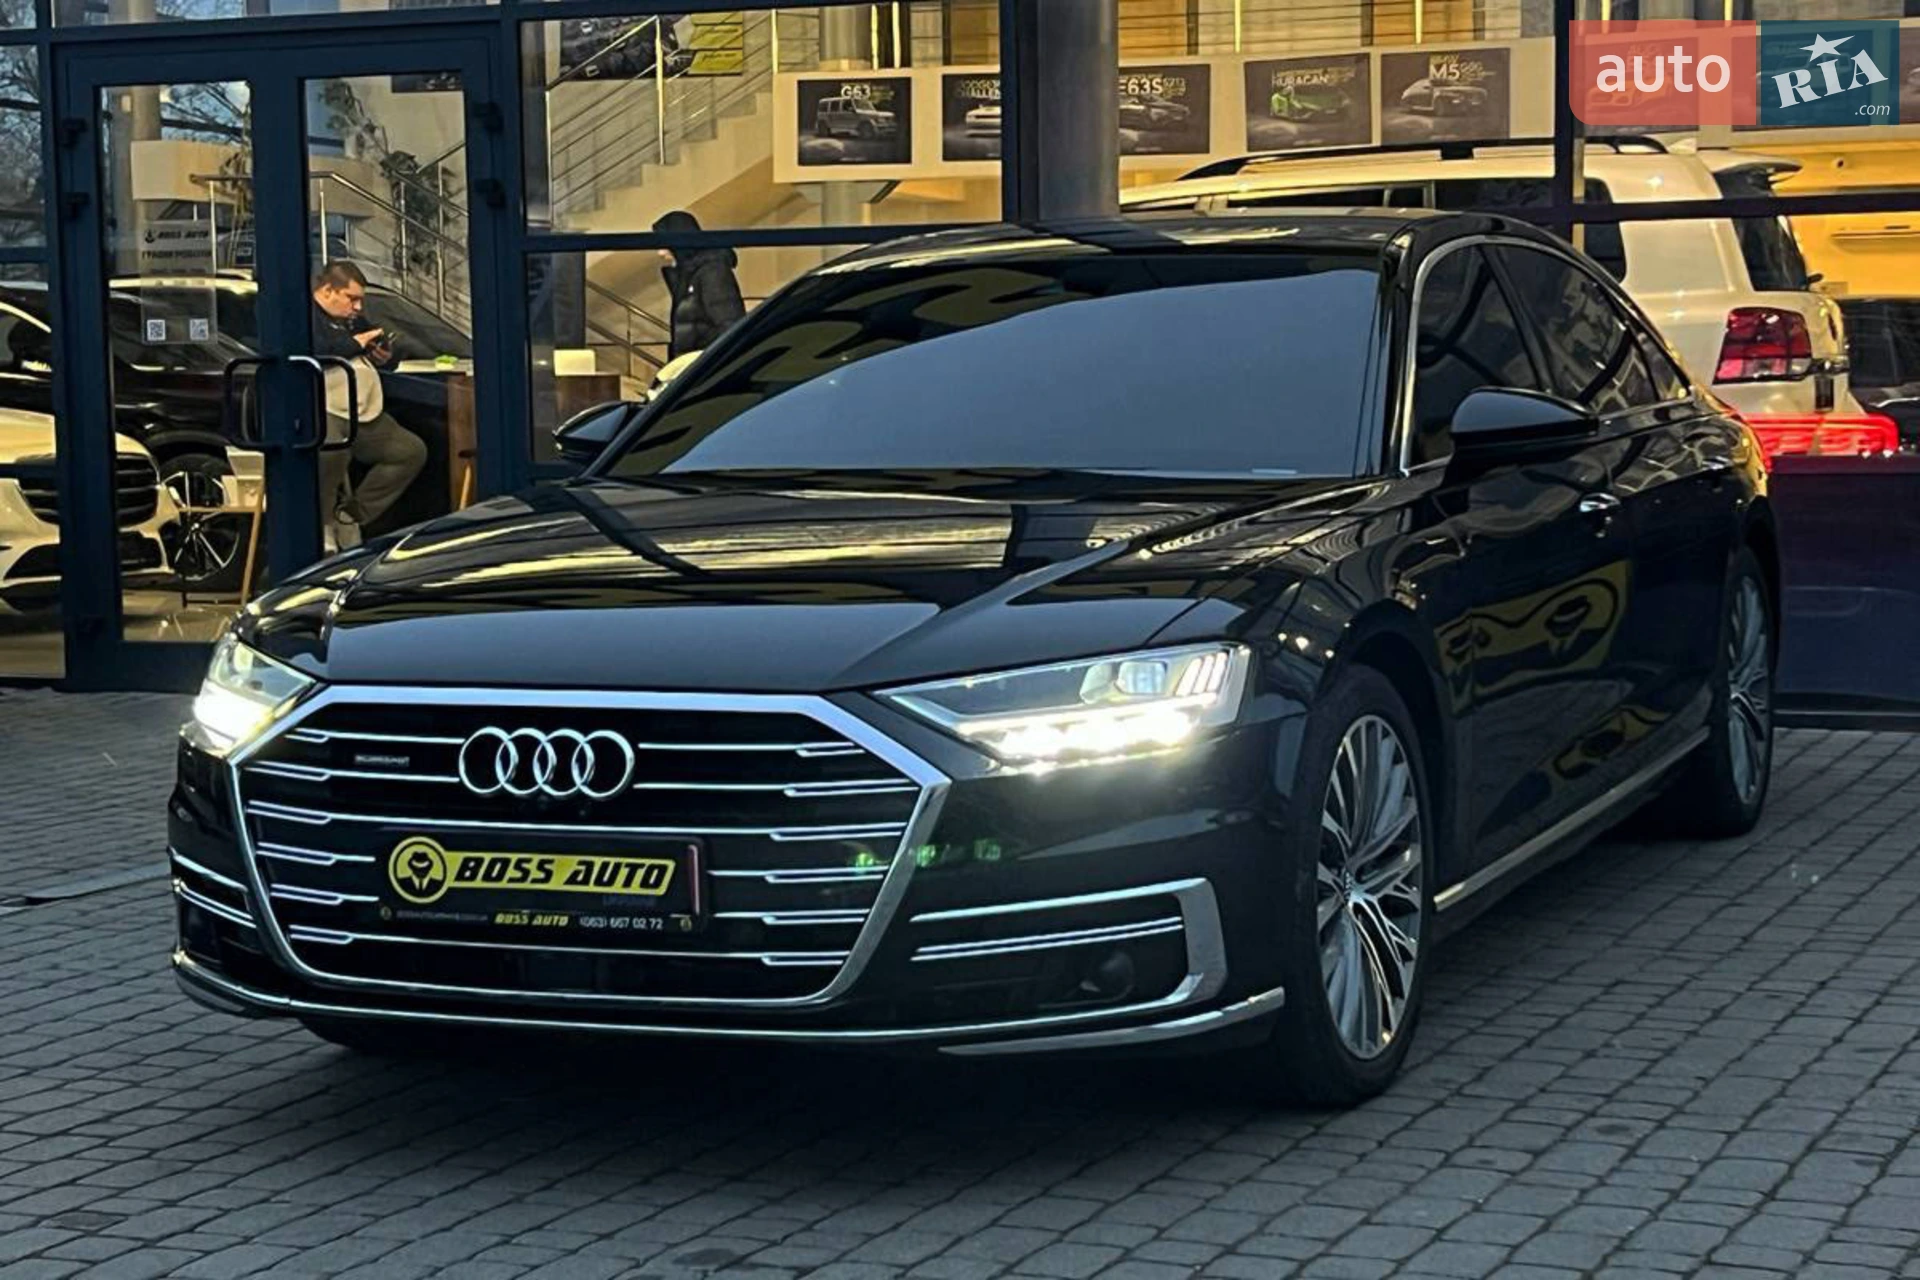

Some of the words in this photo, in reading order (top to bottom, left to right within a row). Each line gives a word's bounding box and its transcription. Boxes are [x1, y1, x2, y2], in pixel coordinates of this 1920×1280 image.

[1430, 63, 1460, 80] M5
[841, 84, 871, 100] G63
[453, 855, 555, 884] BOSS
[562, 859, 670, 890] AUTO
[494, 913, 530, 925] BOSS
[532, 915, 569, 927] AUTO
[649, 918, 664, 930] 72
